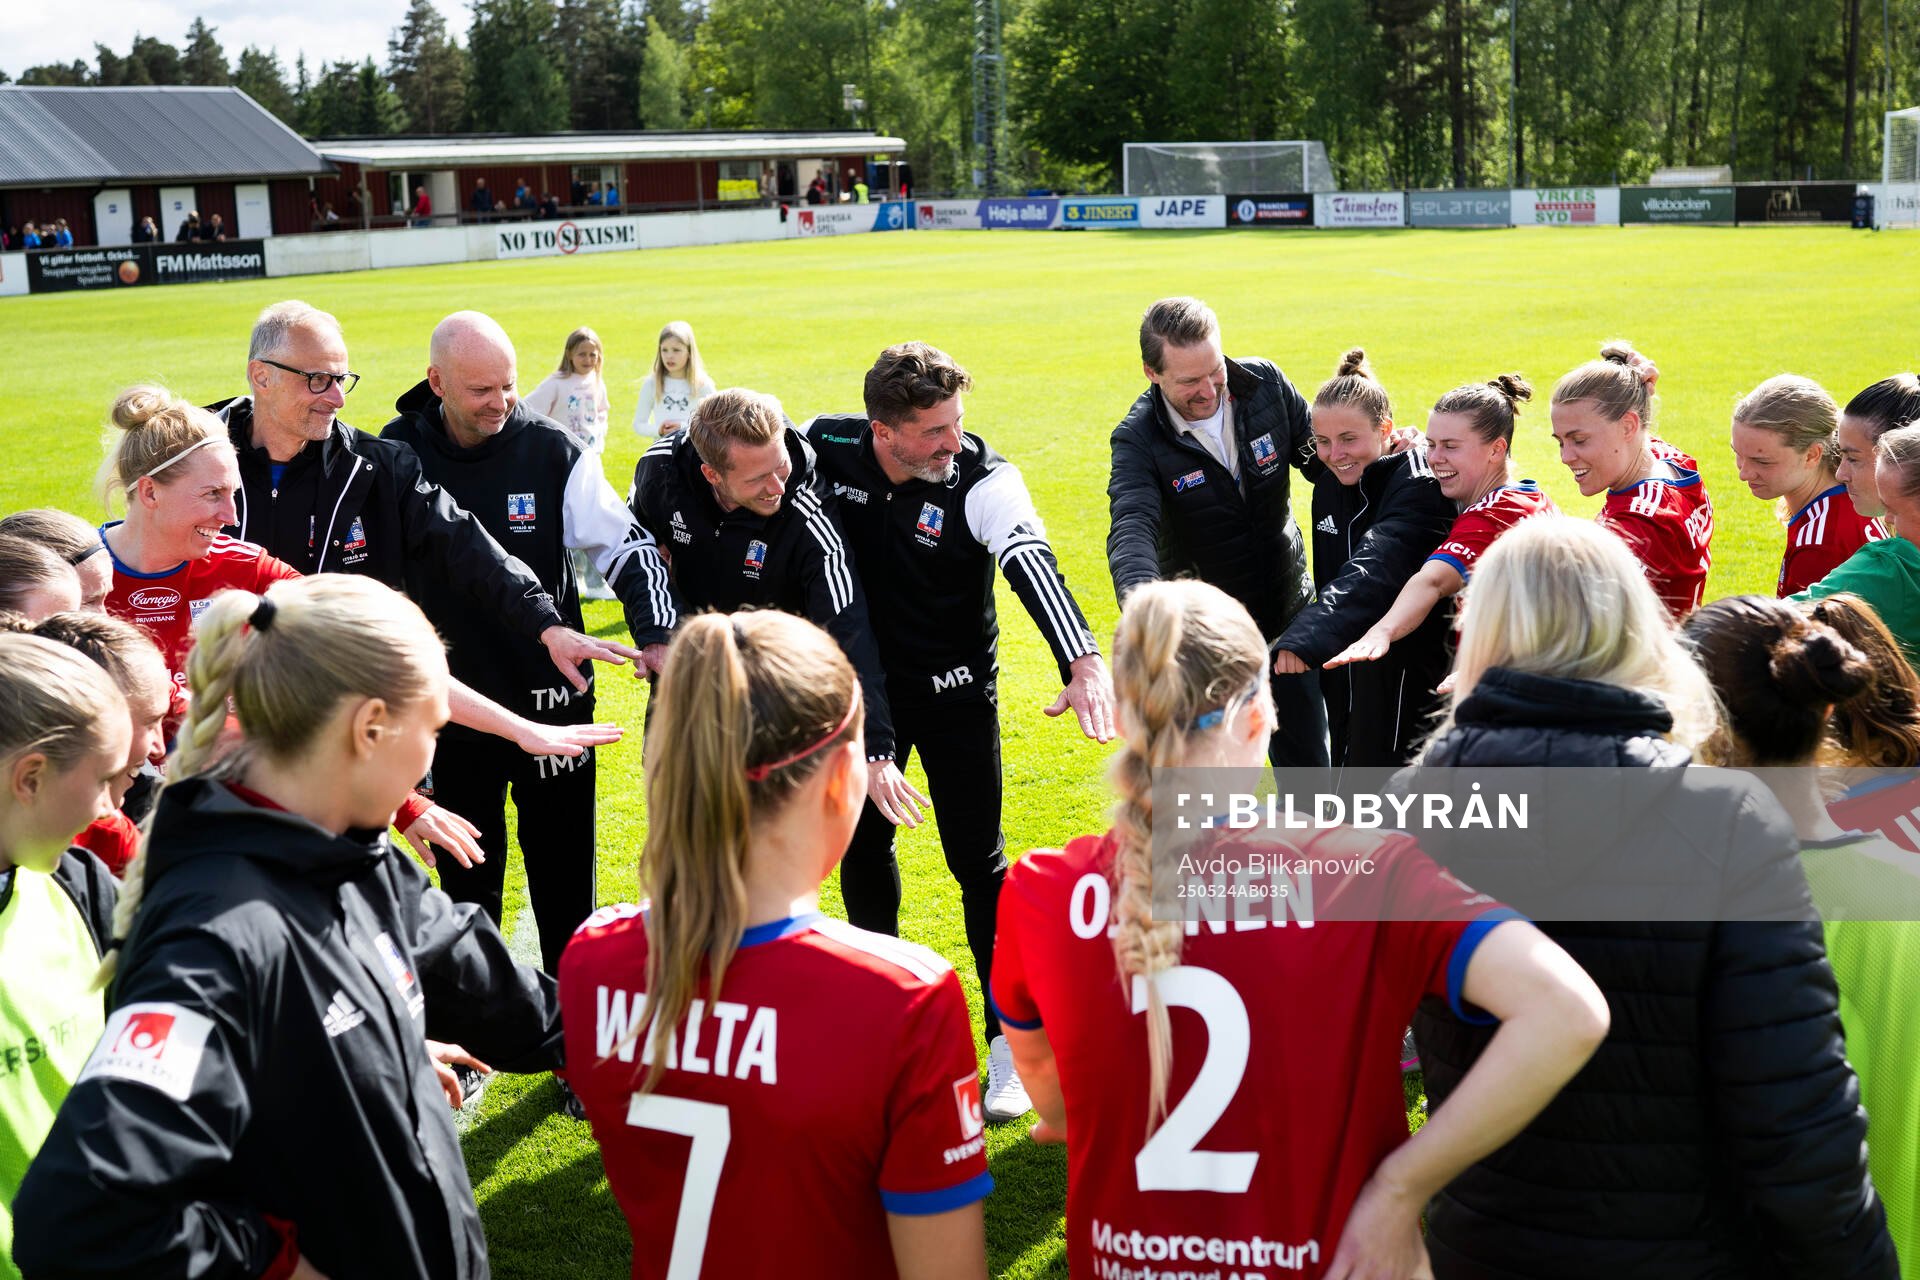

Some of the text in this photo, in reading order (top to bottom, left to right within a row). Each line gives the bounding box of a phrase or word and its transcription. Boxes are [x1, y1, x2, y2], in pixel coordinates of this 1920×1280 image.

[815, 213, 853, 223] SVENSKA
[987, 203, 1048, 223] Heja alla!
[1082, 205, 1135, 220] JINERT
[1154, 199, 1206, 217] JAPE
[499, 225, 636, 251] NO TO SEXISM!
[39, 255, 50, 265] Vi
[156, 253, 261, 273] FM Mattsson
[846, 486, 869, 498] INTER
[846, 493, 869, 505] SPORT
[1316, 524, 1339, 535] adidas
[131, 592, 178, 607] Carnegie
[135, 615, 176, 624] PRIVATBANK
[931, 665, 974, 694] MB
[531, 686, 570, 711] TM
[533, 755, 575, 779] TM
[1069, 863, 1315, 940] ONEN
[596, 985, 778, 1085] WALTA
[1131, 965, 1260, 1194] 2
[625, 1091, 731, 1280] 7
